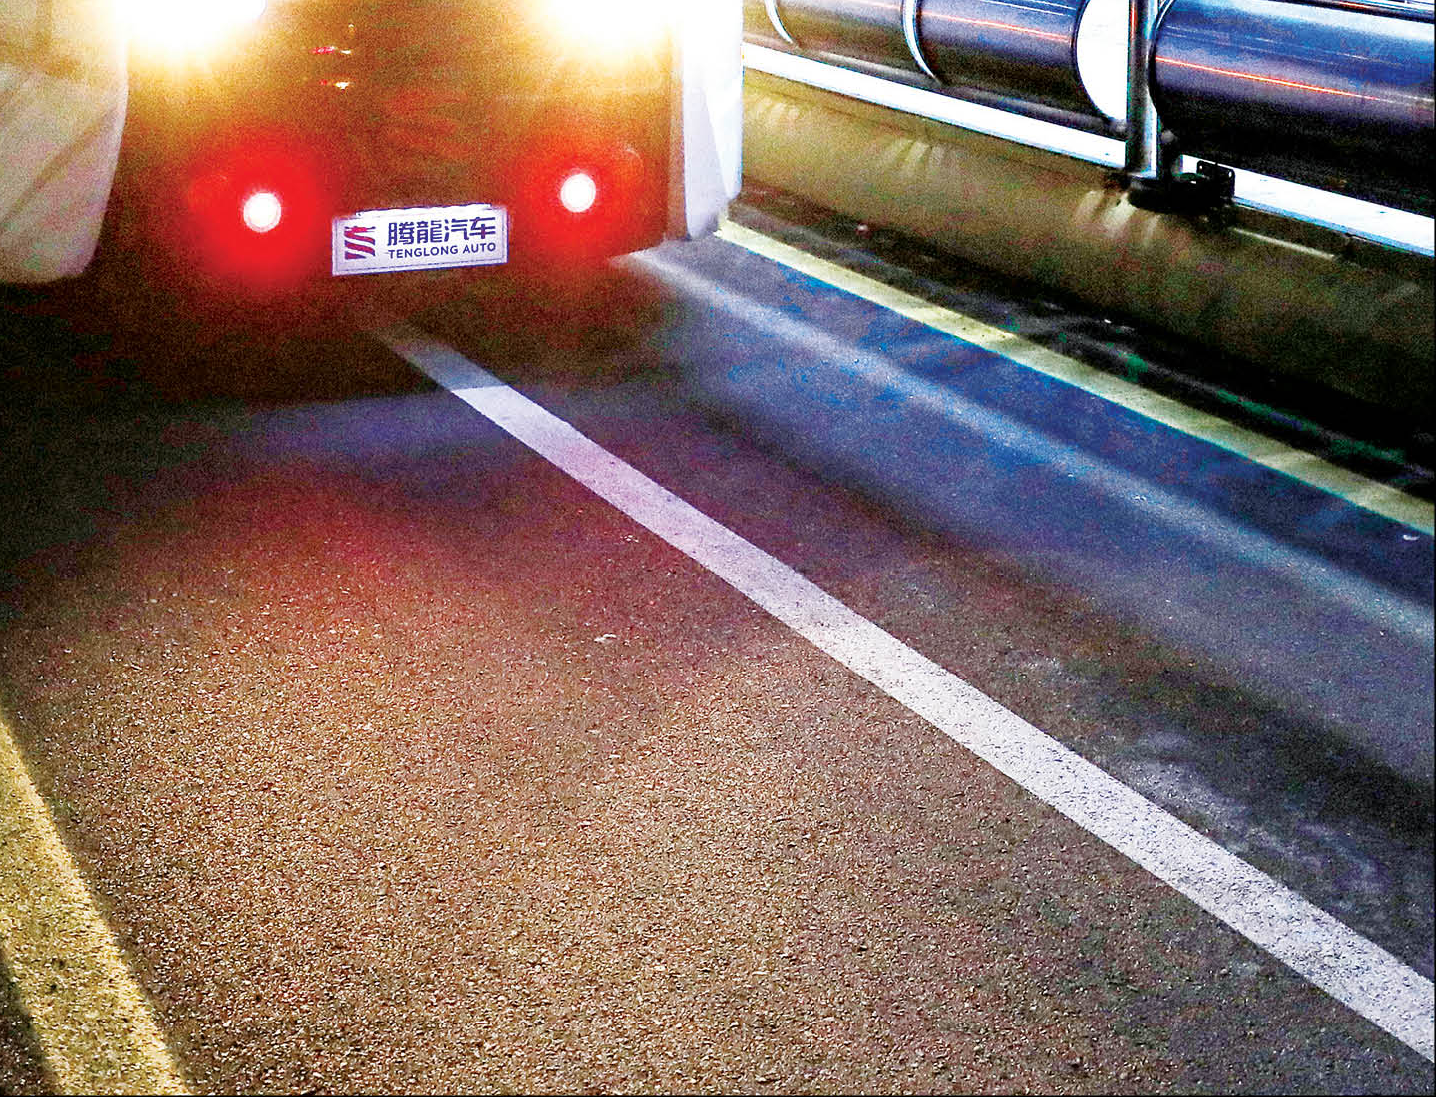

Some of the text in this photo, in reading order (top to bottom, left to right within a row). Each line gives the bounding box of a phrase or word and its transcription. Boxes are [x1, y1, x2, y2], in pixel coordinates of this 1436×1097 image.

[387, 216, 496, 246] 腾龍汽车
[388, 242, 496, 260] TENGLONG AUTO
